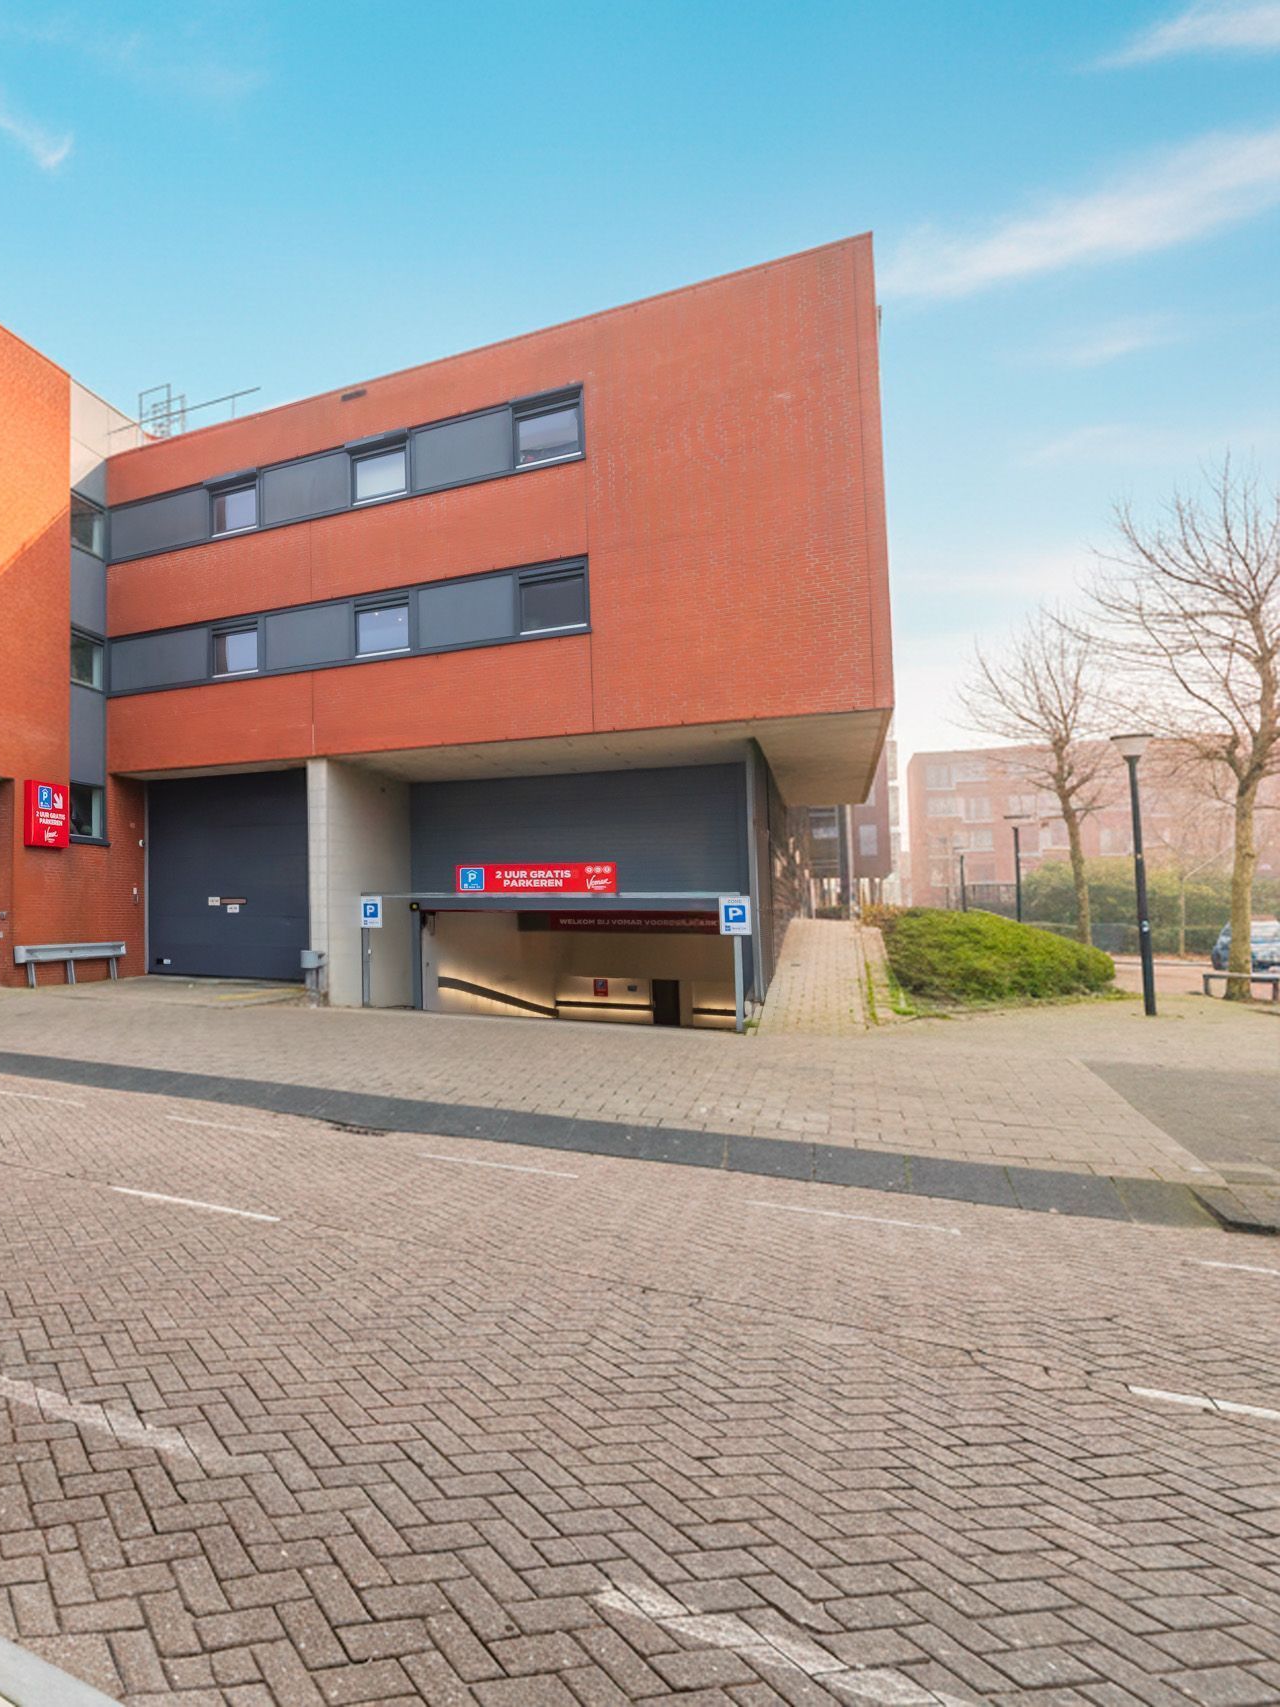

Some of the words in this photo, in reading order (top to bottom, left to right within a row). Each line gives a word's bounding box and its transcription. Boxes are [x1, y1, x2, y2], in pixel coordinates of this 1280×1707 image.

[50, 812, 66, 820] GRATIS
[39, 818, 63, 826] PARKEREN
[495, 870, 502, 879] 2
[504, 870, 527, 879] UUR
[530, 869, 572, 878] GRATIS
[503, 879, 563, 888] PARKEREN
[367, 905, 375, 916] P
[729, 907, 743, 921] P
